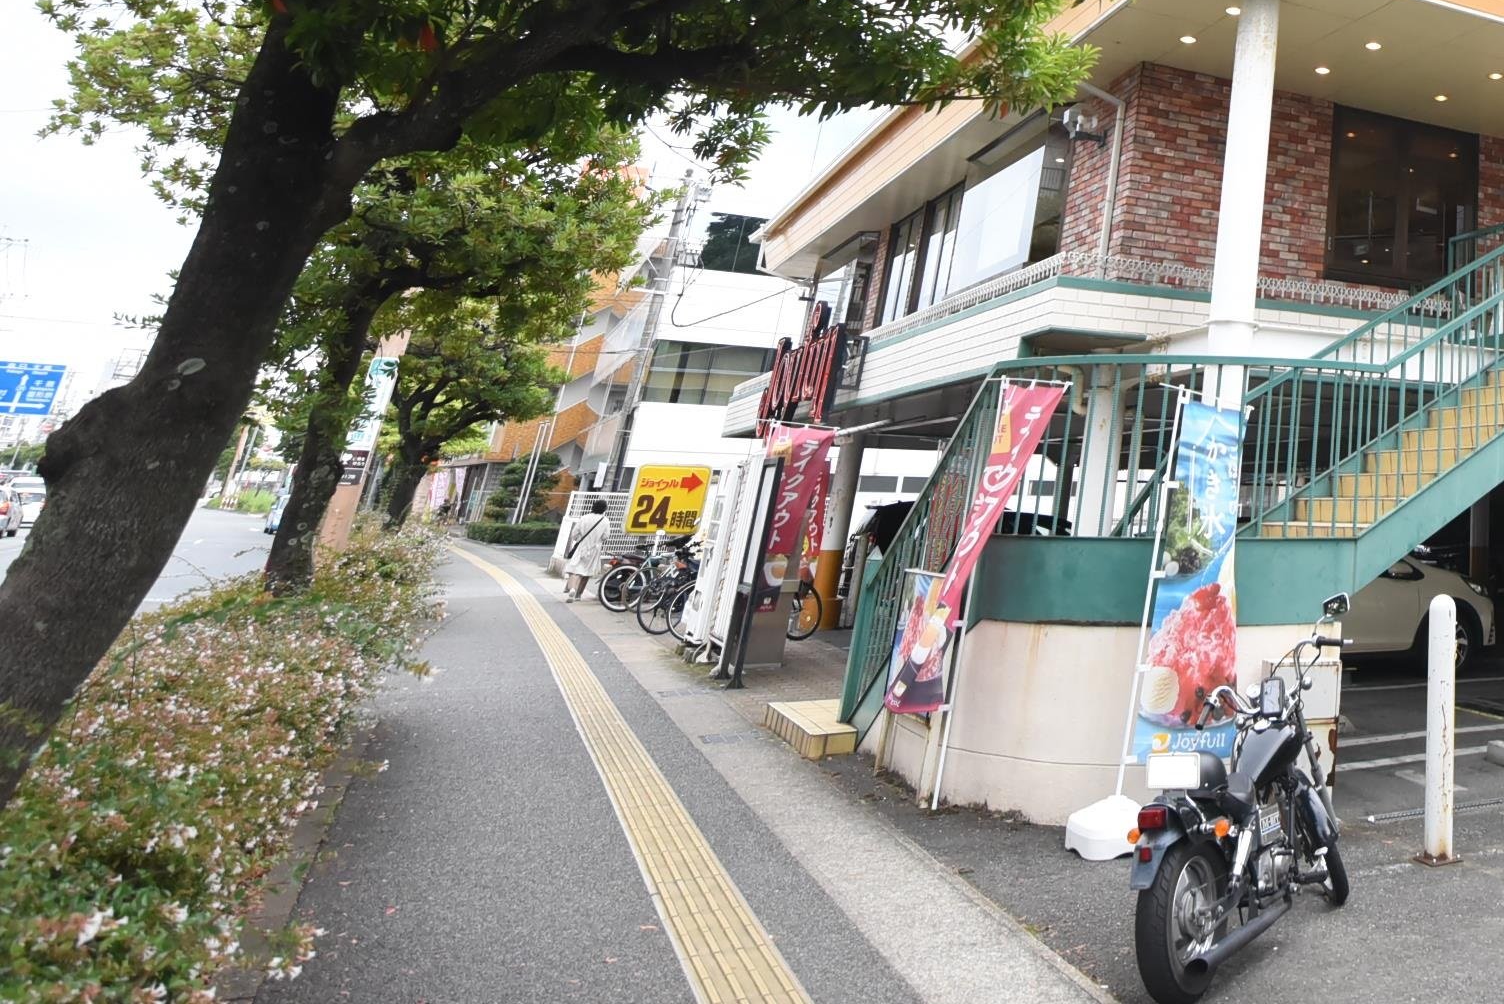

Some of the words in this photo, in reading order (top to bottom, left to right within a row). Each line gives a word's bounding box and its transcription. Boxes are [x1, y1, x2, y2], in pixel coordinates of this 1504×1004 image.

[640, 477, 679, 492] ジョイフル
[769, 439, 820, 550] テイクアウト
[1172, 731, 1226, 752] Joyfull
